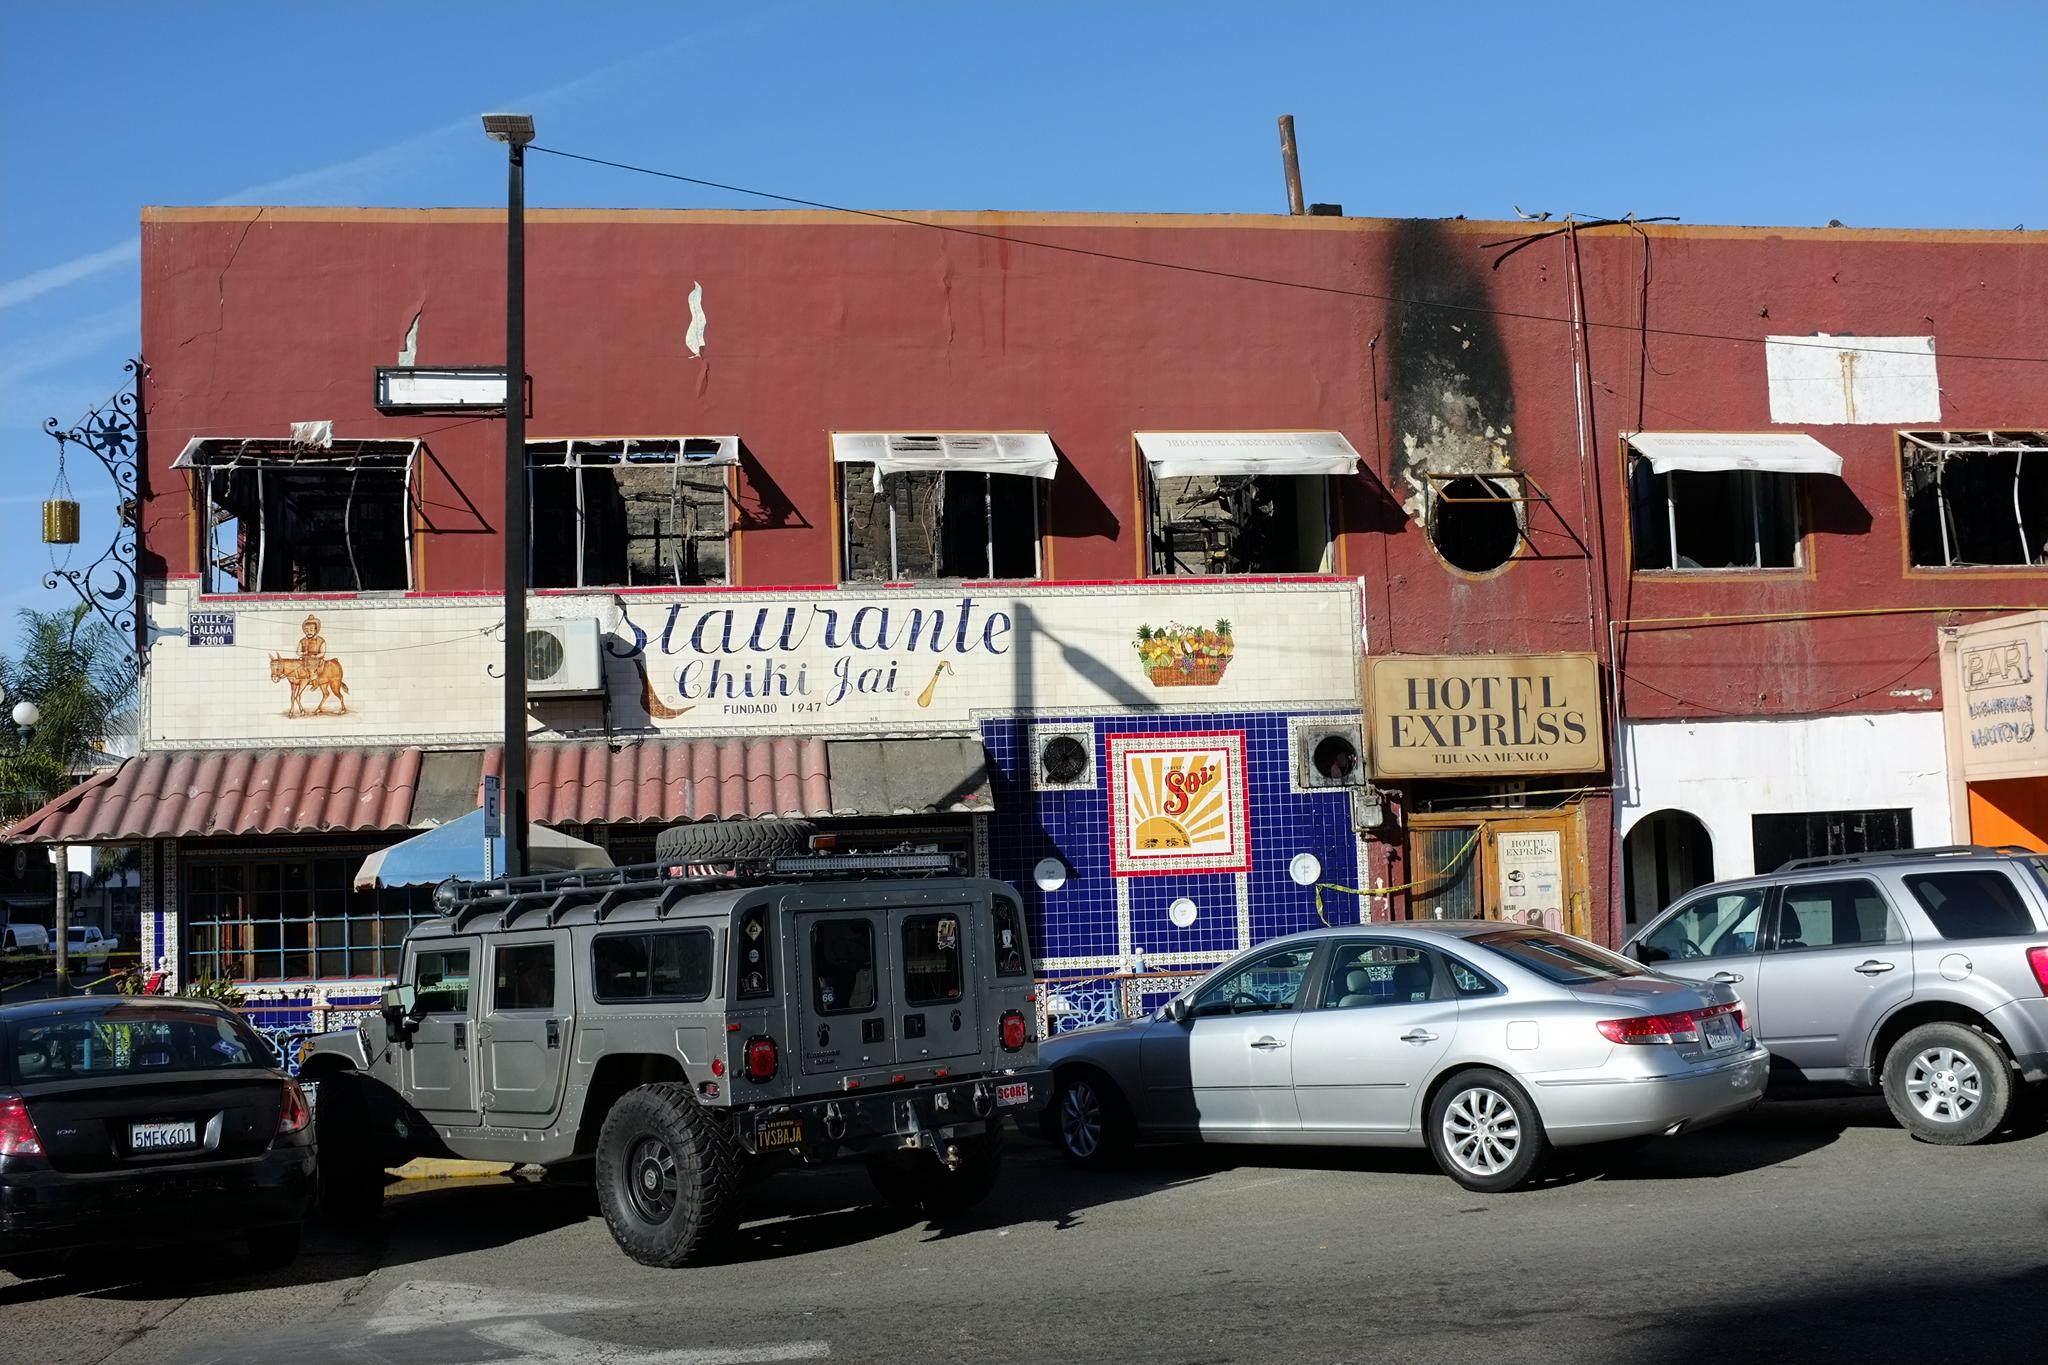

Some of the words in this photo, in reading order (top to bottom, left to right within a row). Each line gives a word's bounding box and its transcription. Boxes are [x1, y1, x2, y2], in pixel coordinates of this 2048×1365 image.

[191, 615, 221, 624] CALLE
[192, 625, 233, 634] GALEANA
[605, 598, 1012, 658] staurante
[200, 636, 225, 645] 2000
[1967, 645, 2023, 687] BAR
[674, 656, 812, 699] Chiki
[1404, 676, 1568, 711] HOTEL
[723, 703, 778, 715] FUNDADO
[791, 702, 822, 713] 1947
[1388, 710, 1587, 748] EXPRESS
[1432, 752, 1489, 765] TIJUANA
[1493, 751, 1549, 764] MEXICO
[1506, 847, 1553, 857] EXPRESS
[1511, 839, 1547, 849] HOTEL
[998, 1084, 1026, 1100] SCORE
[135, 1128, 192, 1147] 5MEK601
[757, 1126, 802, 1147] TVSBAJA
